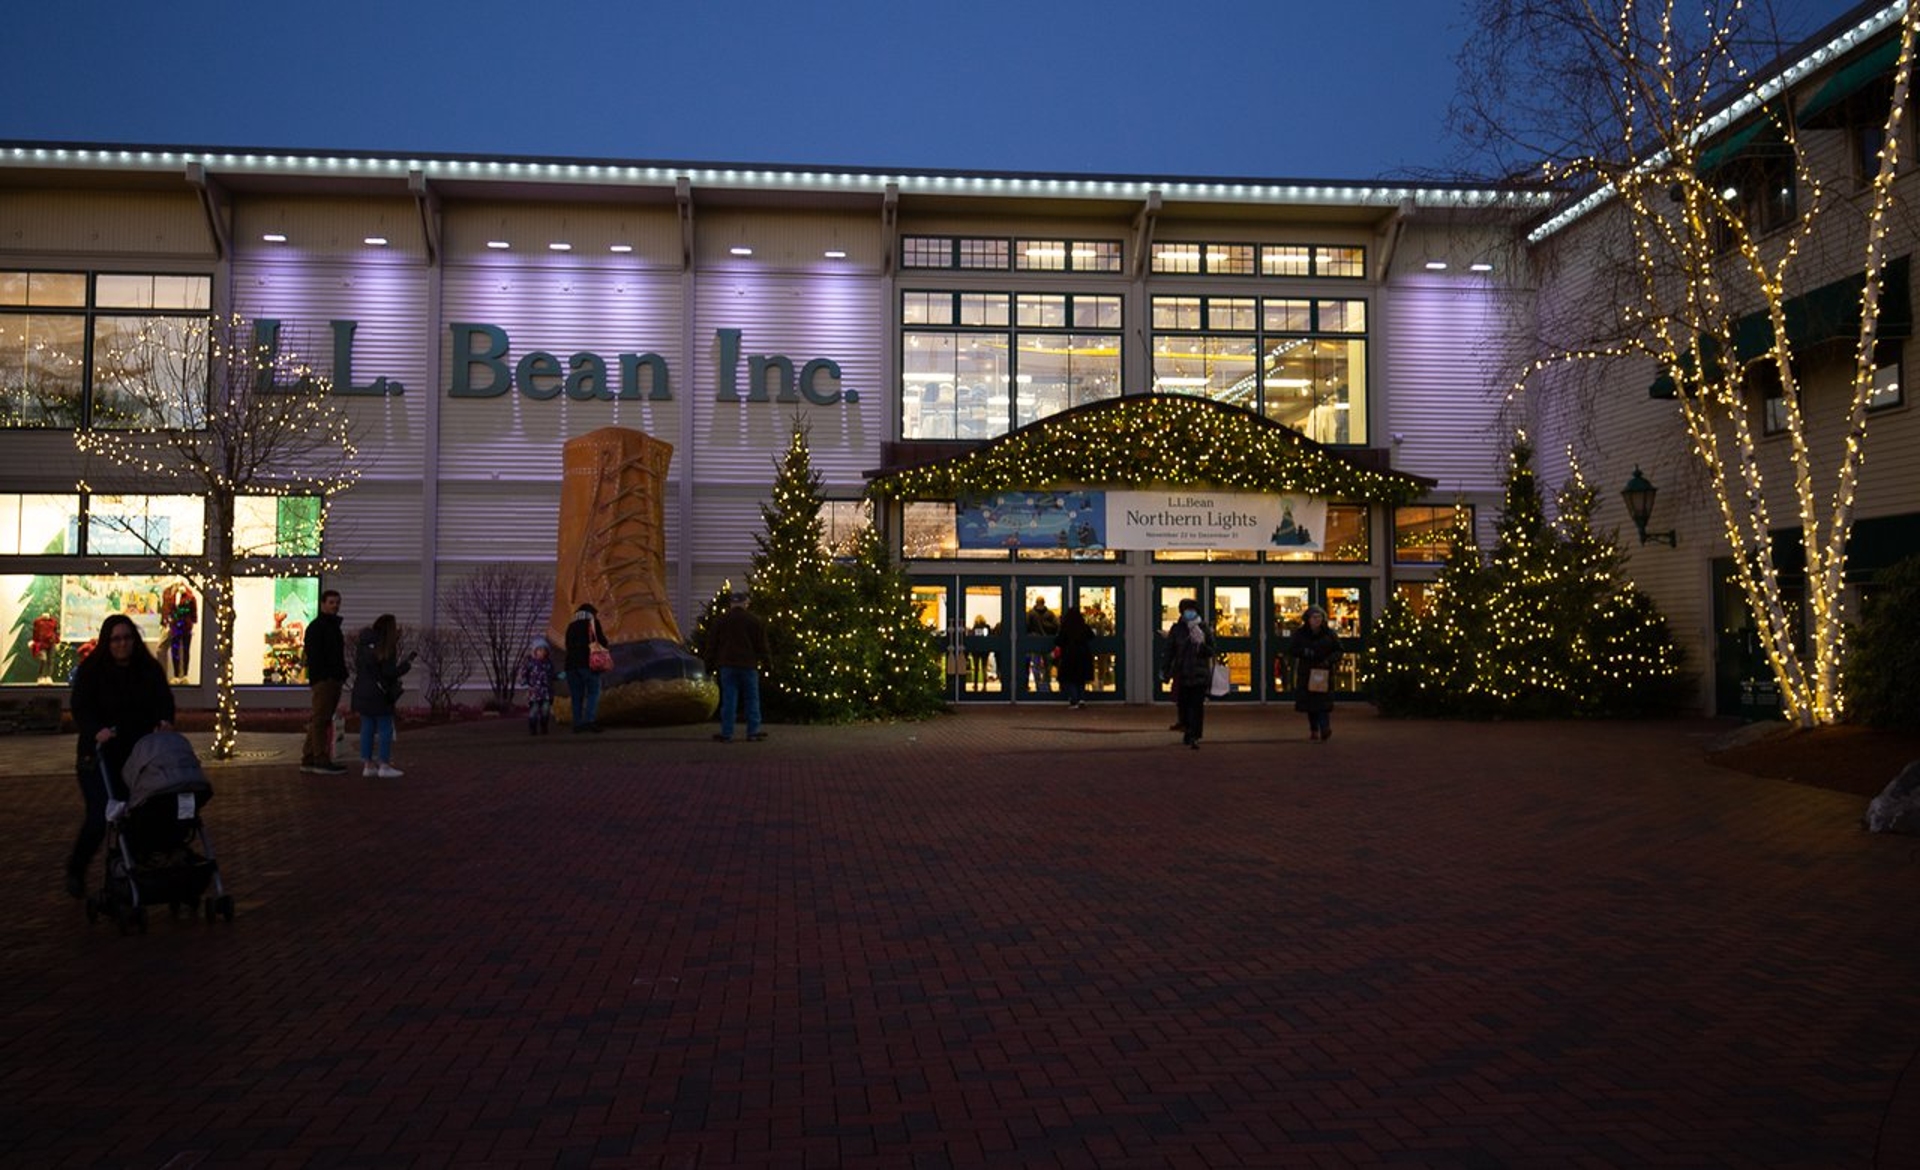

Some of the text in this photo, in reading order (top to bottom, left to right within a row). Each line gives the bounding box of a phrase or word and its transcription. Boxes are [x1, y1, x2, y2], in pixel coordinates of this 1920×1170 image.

[447, 322, 673, 401] Bean
[716, 328, 860, 406] Inc.
[1126, 510, 1257, 529] Northern Lights
[1198, 531, 1230, 539] December
